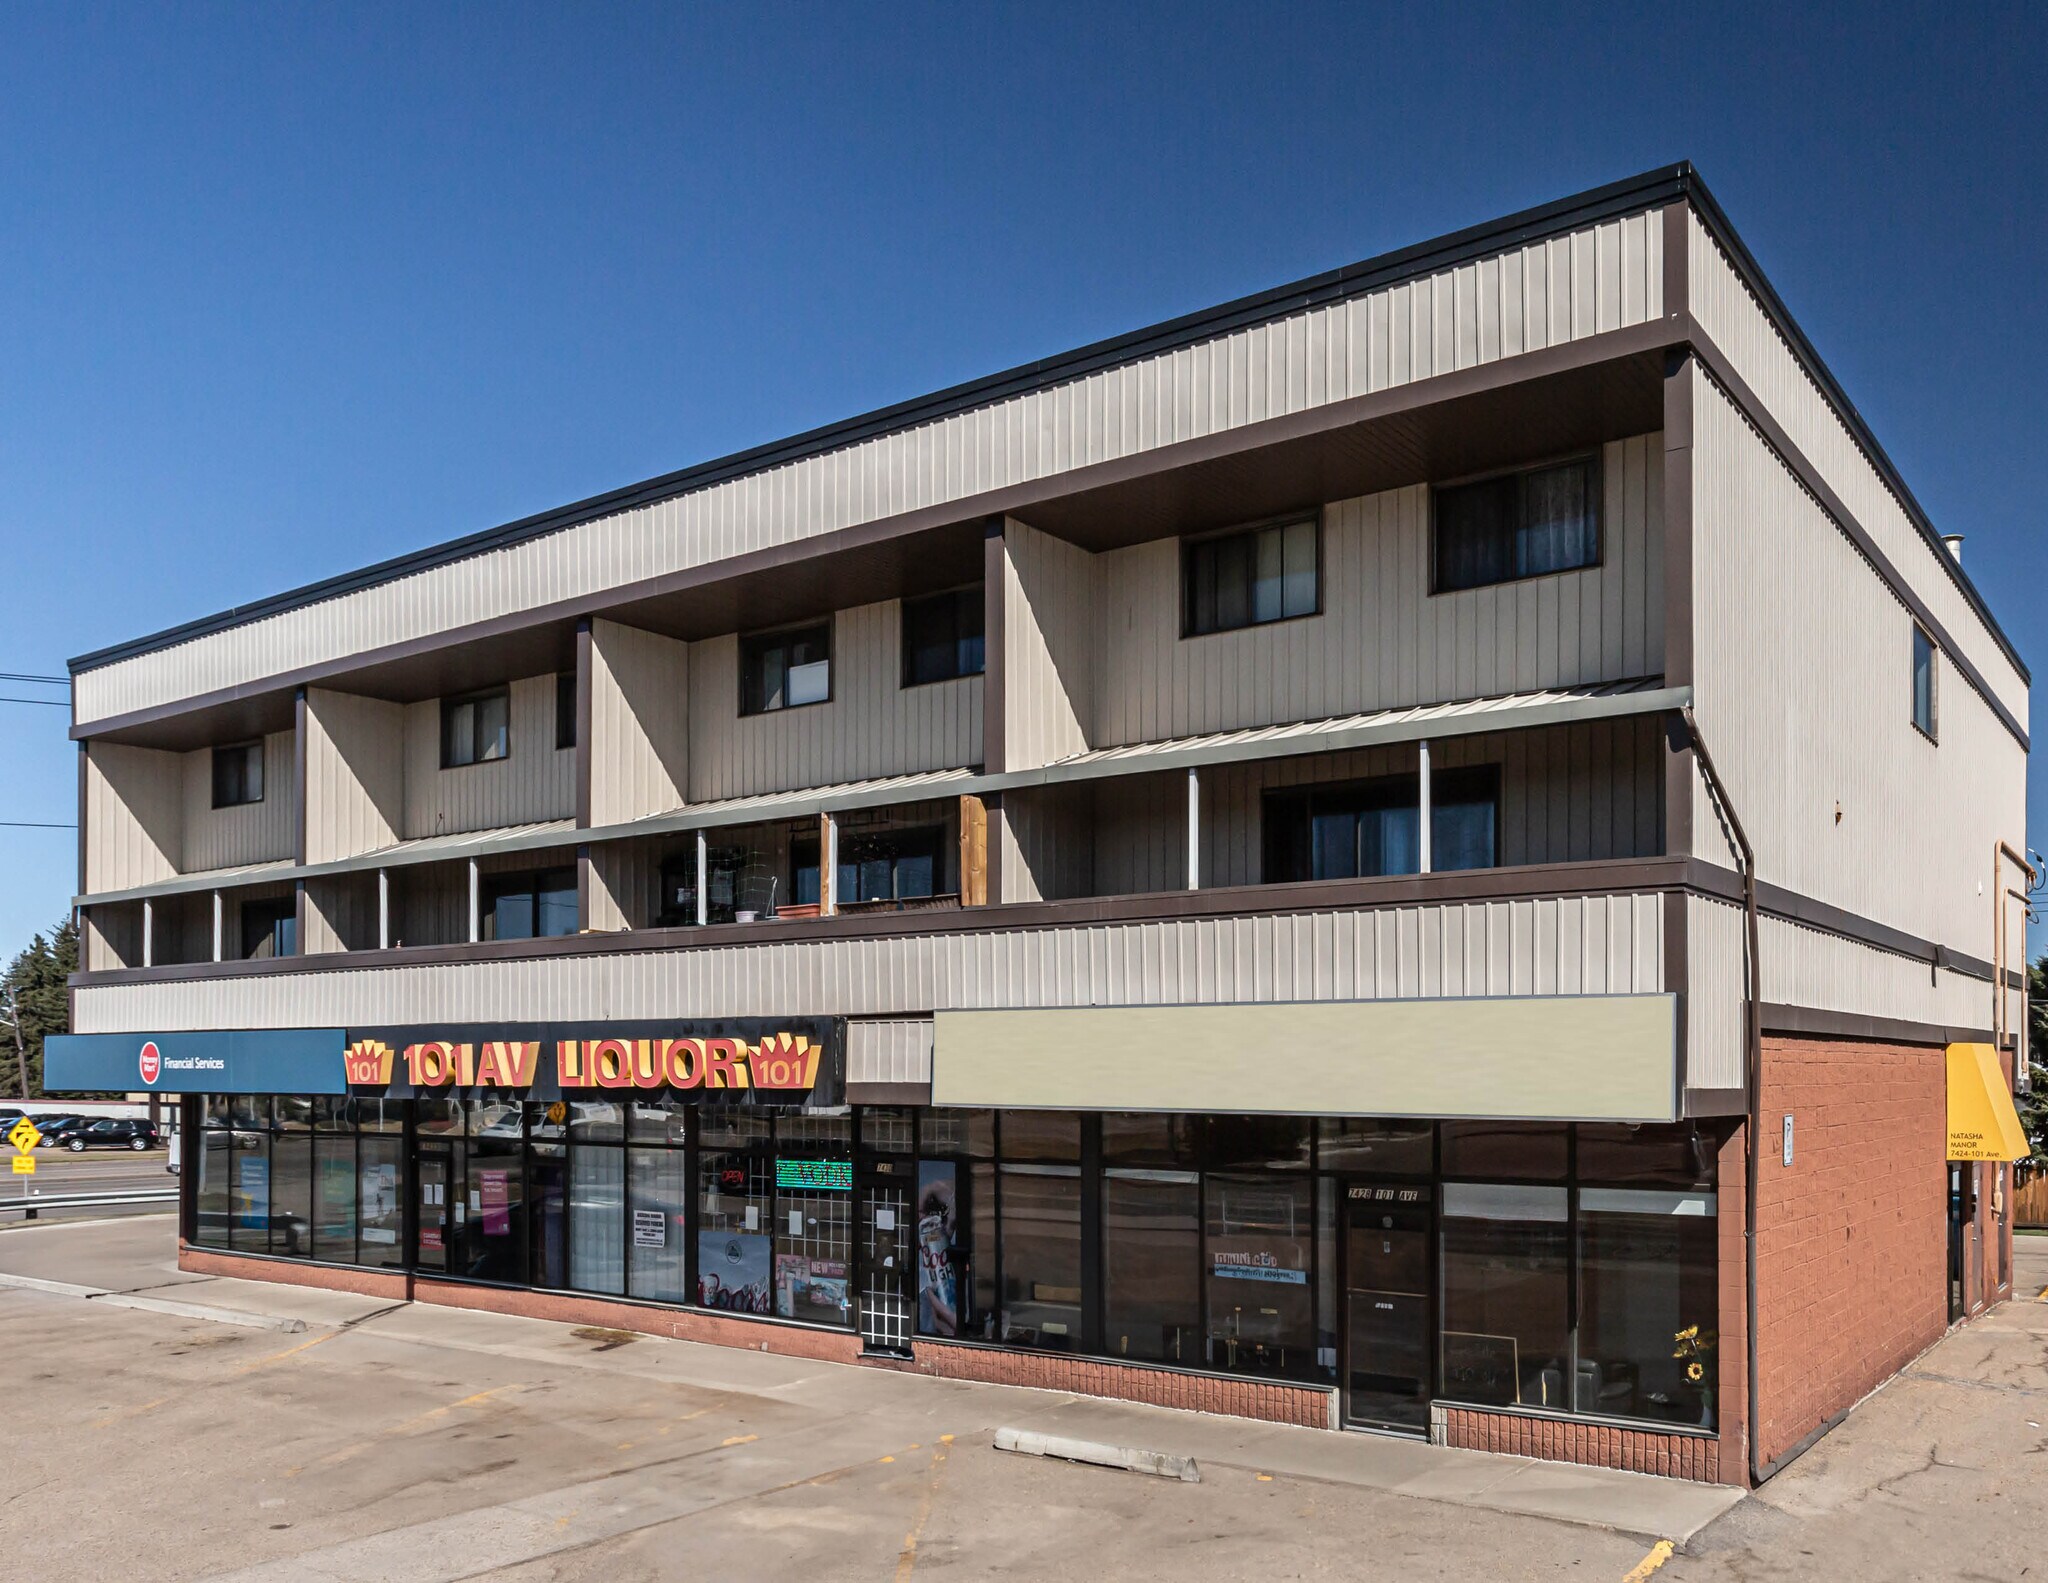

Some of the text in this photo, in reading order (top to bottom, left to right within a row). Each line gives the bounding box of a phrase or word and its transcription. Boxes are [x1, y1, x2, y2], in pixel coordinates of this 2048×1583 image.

[164, 1057, 225, 1070] Financial Services
[403, 1038, 749, 1089] 101 AV LIQUOR
[351, 1061, 379, 1082] 101
[759, 1059, 802, 1085] 101
[1950, 1132, 1984, 1140] NATASHA
[1950, 1141, 1978, 1149] MANOR
[720, 1169, 745, 1183] OPEN
[1375, 1189, 1395, 1200] 101
[1398, 1190, 1418, 1202] AVE
[811, 1261, 828, 1274] NEW
